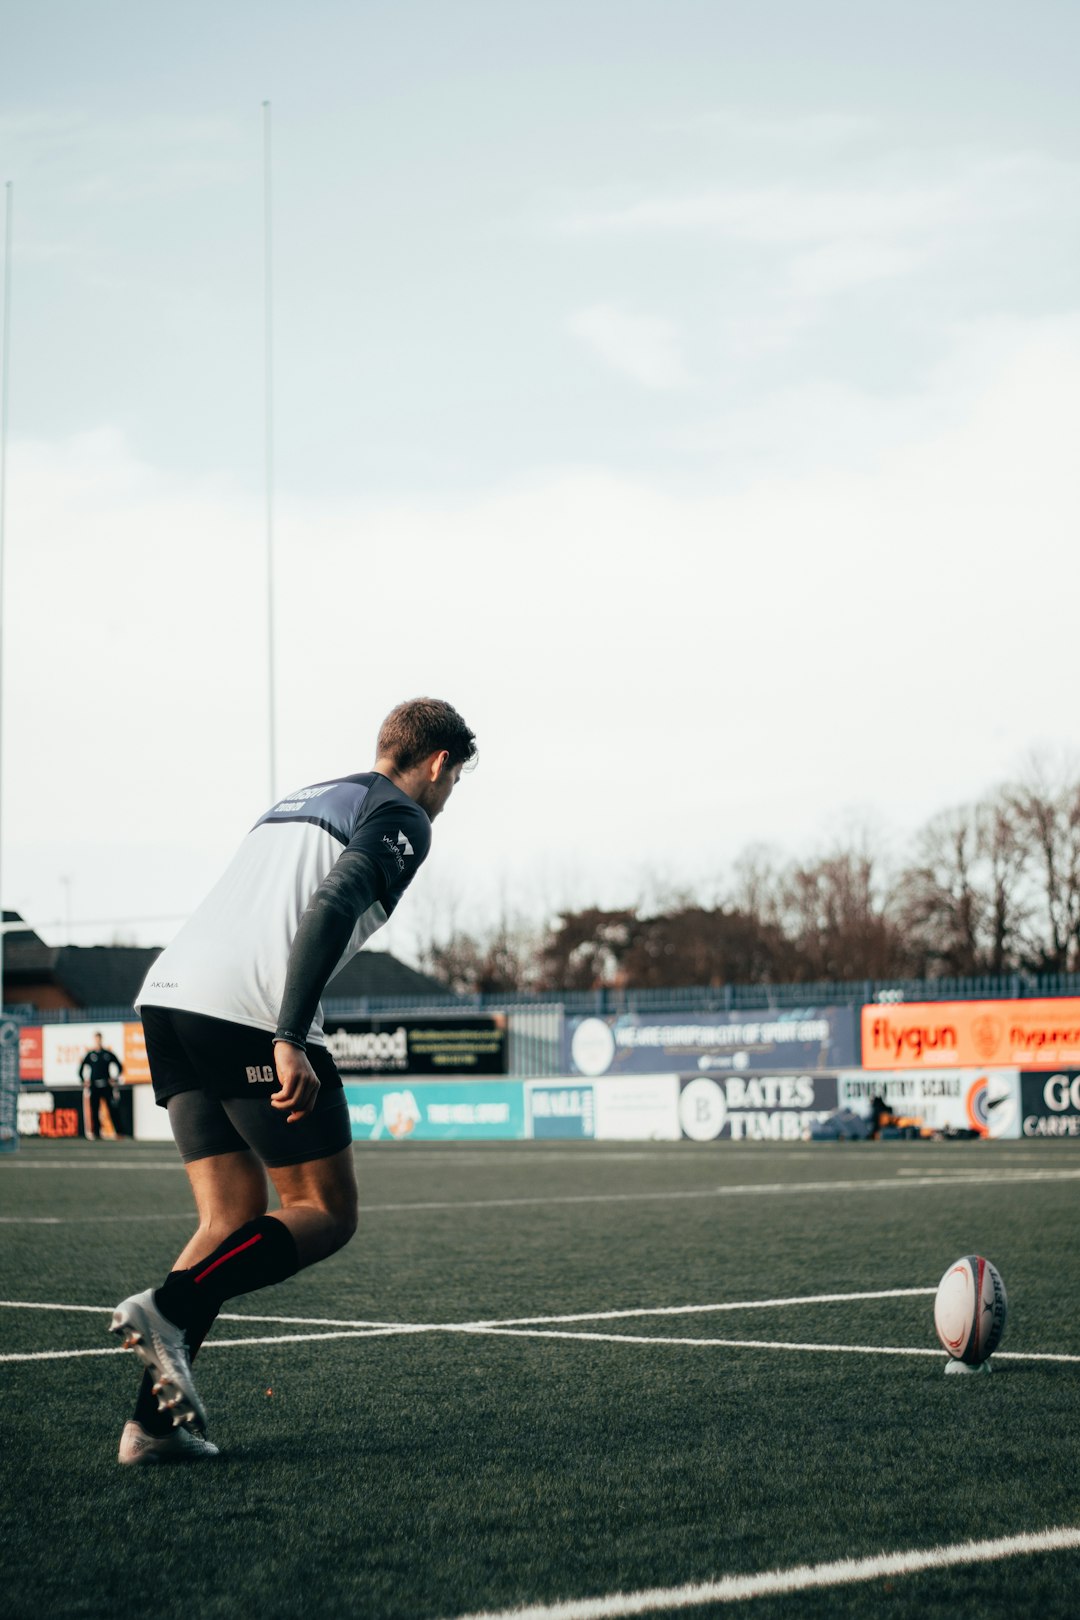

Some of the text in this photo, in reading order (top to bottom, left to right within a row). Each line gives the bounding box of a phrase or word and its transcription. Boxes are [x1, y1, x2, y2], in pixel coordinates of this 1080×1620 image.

[382, 834, 405, 871] WARWICK
[151, 981, 179, 989] AKUMA
[871, 1018, 957, 1059] flygun
[245, 1065, 274, 1084] BLG
[725, 1076, 815, 1109] BATES
[845, 1078, 961, 1098] COVENTRY SCALE
